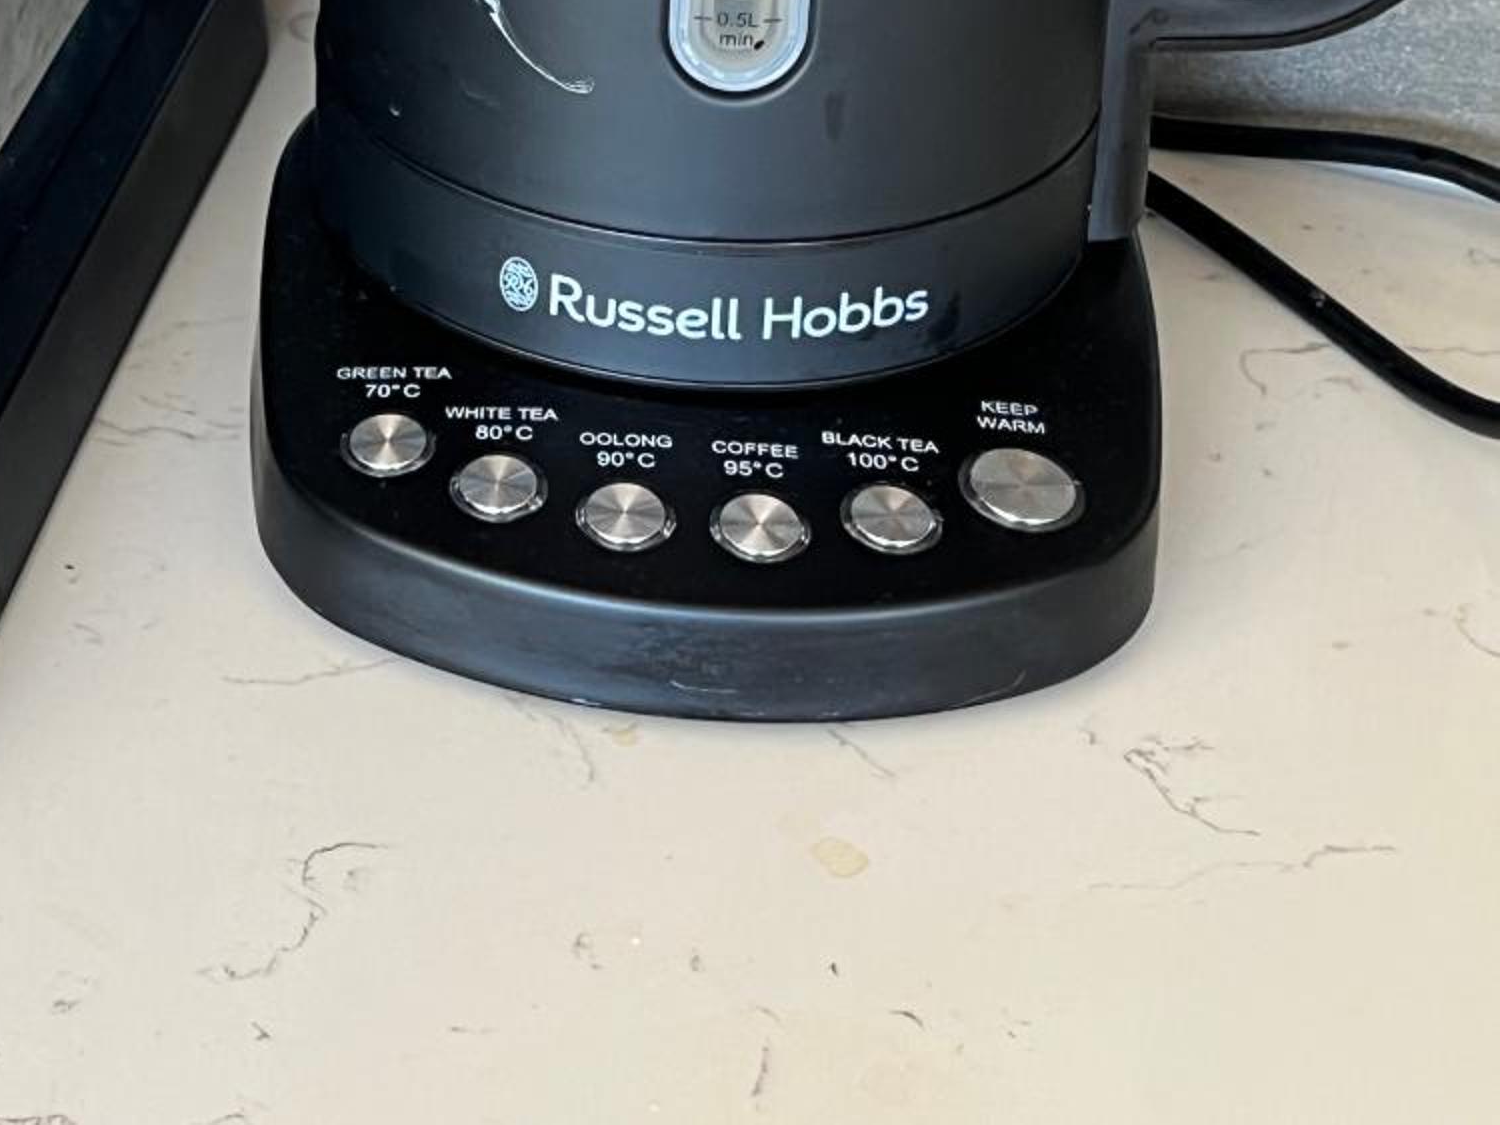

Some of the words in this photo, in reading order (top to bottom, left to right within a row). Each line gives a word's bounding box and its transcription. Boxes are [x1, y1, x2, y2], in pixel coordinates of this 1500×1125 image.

[719, 30, 753, 46] min
[549, 274, 741, 339] Russell
[762, 286, 929, 339] Hobbs
[337, 367, 406, 380] GREEN
[413, 366, 452, 380] TEA
[445, 406, 511, 420] WHITE
[518, 407, 559, 422] TEA
[980, 400, 1038, 416] KEEP
[976, 415, 1046, 435] WARM
[579, 432, 673, 448] OOLONG
[821, 431, 892, 450] BLACK
[898, 437, 940, 454] TEA
[711, 440, 800, 459] COFFEE
